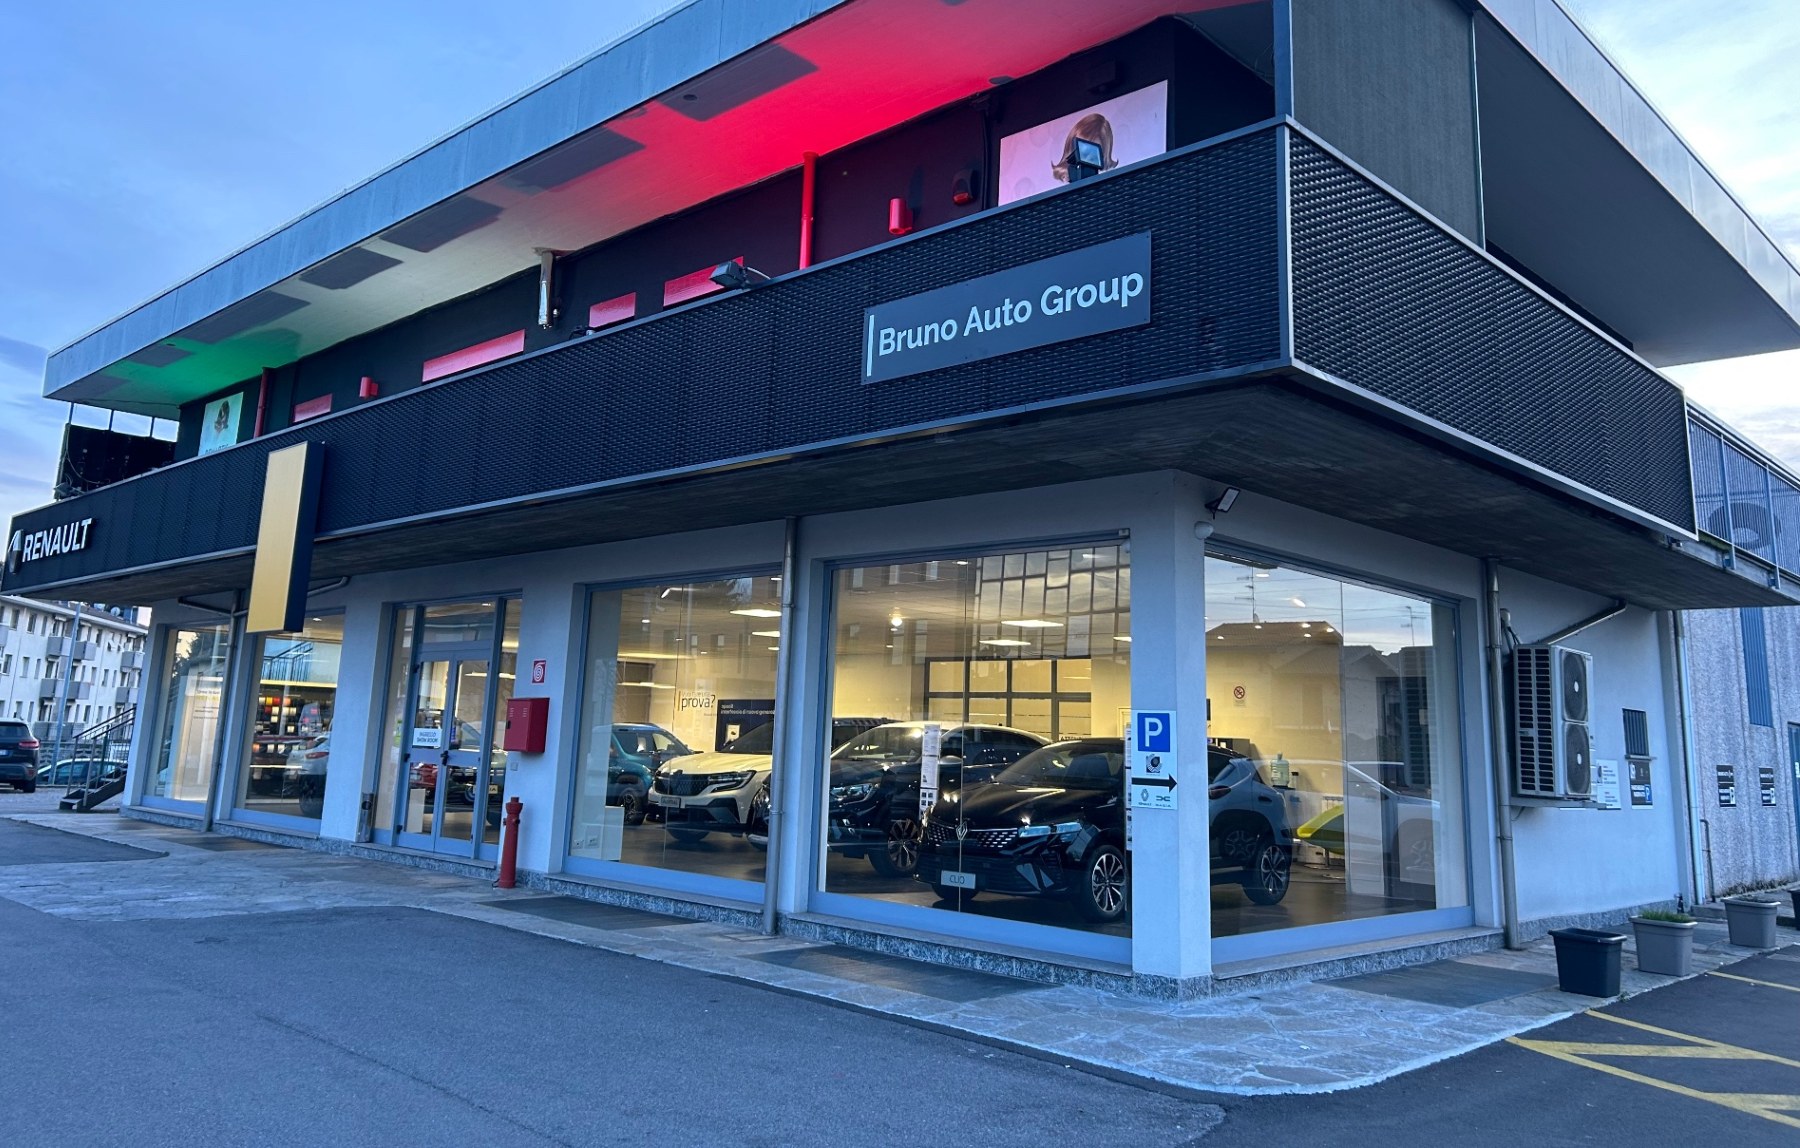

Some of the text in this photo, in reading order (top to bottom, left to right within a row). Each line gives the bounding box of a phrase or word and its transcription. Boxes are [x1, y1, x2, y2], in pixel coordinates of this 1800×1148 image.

[879, 272, 1144, 356] Bruno Auto Group
[22, 518, 92, 563] RENAULT
[681, 694, 716, 711] prova?
[1145, 717, 1163, 747] P
[949, 874, 965, 884] CLIO
